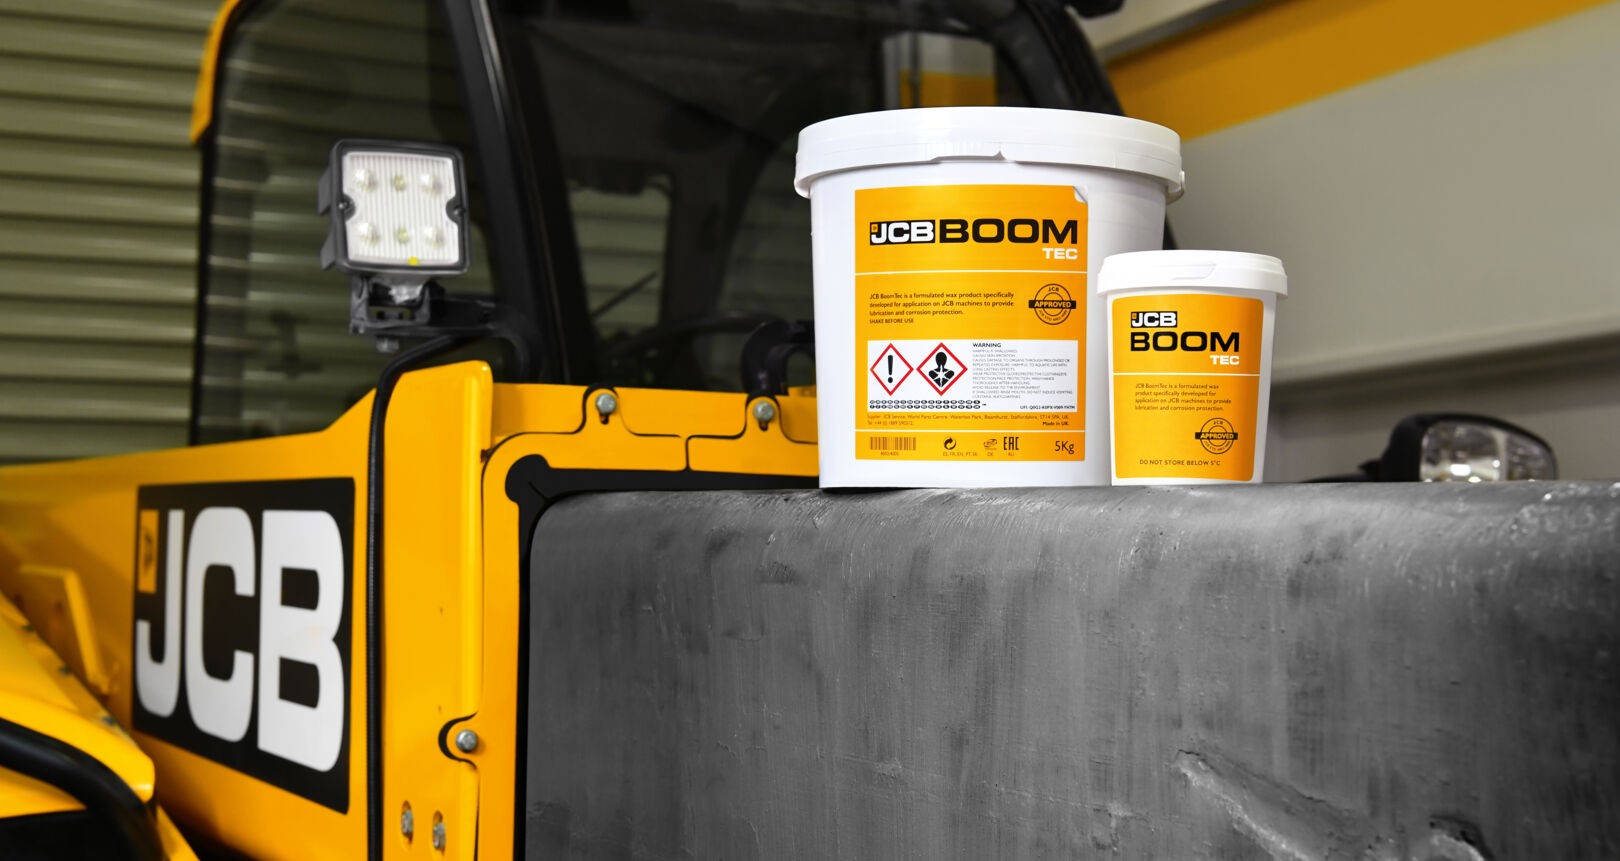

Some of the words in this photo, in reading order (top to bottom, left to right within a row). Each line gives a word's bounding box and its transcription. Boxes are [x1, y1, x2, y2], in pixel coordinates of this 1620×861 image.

[870, 221, 935, 244] JCB
[939, 218, 1078, 244] BOOM
[1042, 247, 1078, 260] TEC
[991, 300, 1014, 308] provide
[1131, 311, 1177, 328] JCB
[1130, 331, 1240, 352] BOOM
[1209, 355, 1240, 366] TEC
[1003, 436, 1020, 451] EAC
[1055, 440, 1075, 455] 5Kg
[136, 506, 344, 772] JCB
